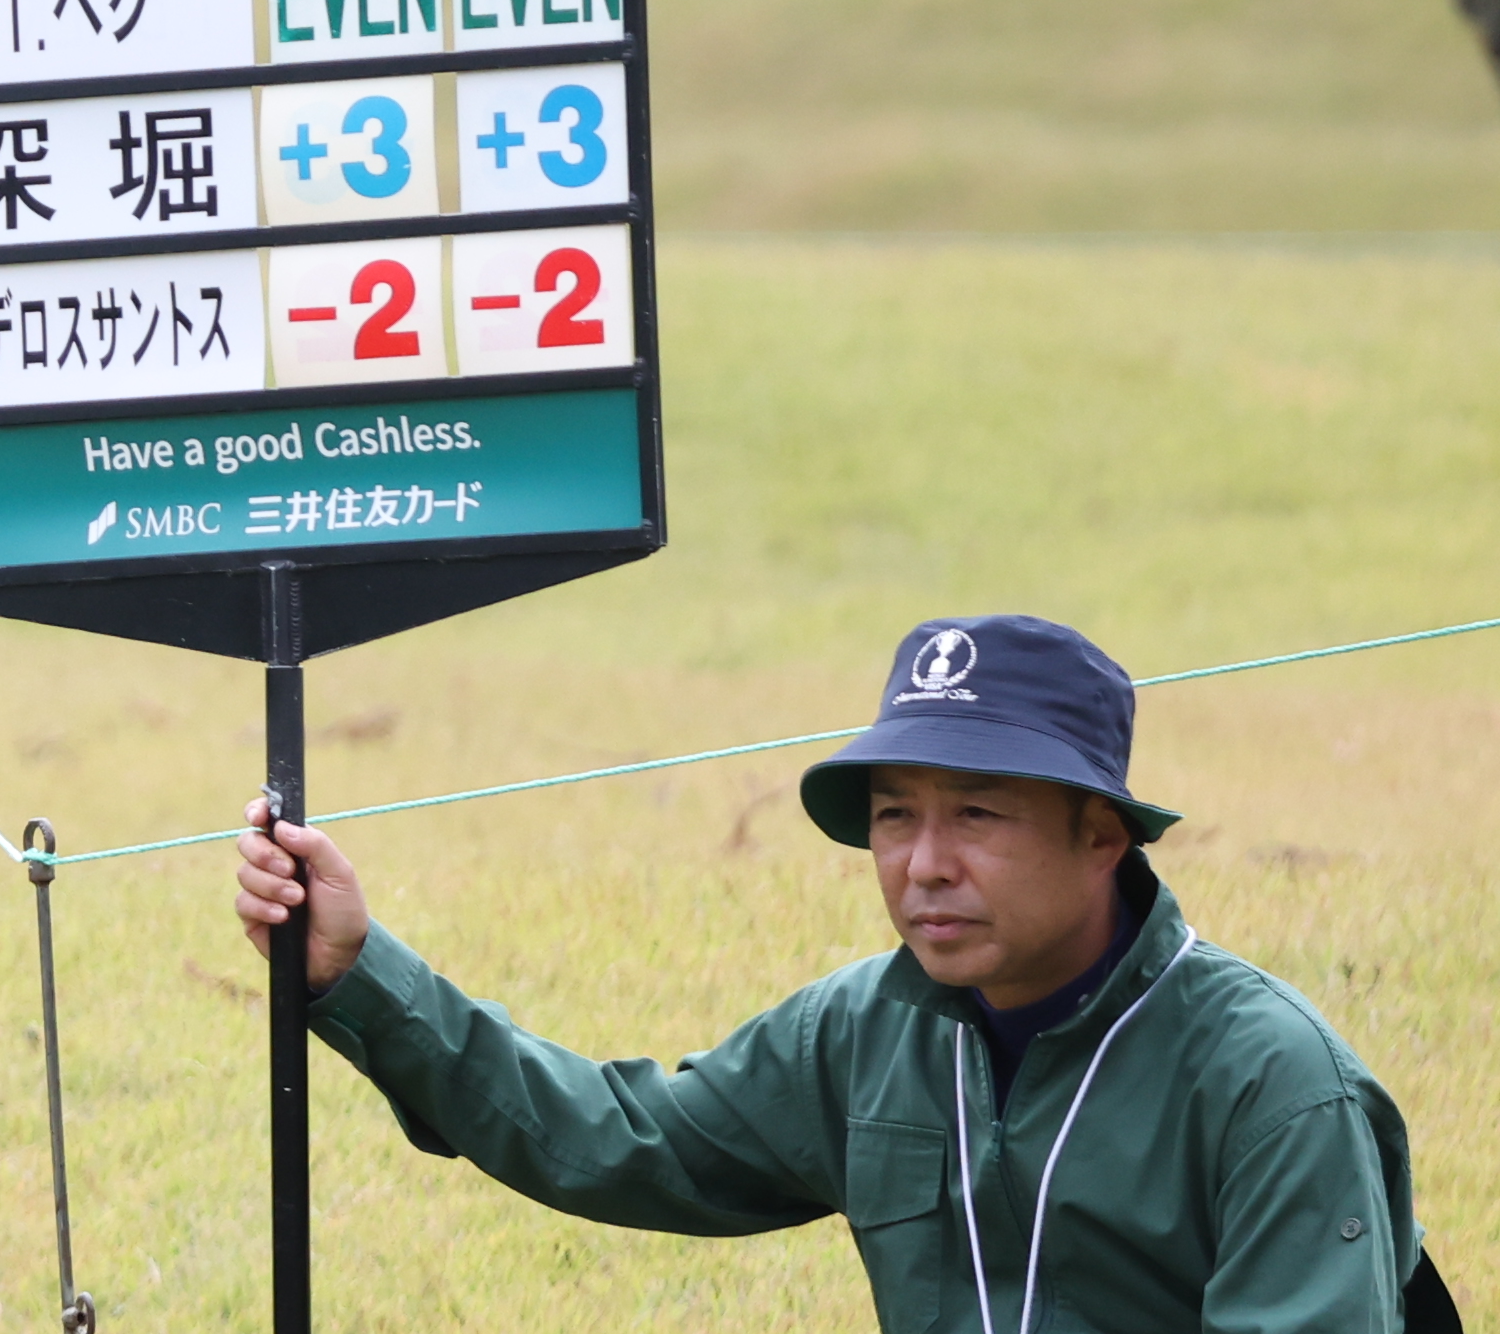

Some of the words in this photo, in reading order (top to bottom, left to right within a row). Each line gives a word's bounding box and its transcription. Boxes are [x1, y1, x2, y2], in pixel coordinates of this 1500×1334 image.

[278, 95, 412, 199] +3
[476, 84, 608, 188] +3
[287, 258, 421, 360] -2
[471, 247, 606, 348] -2
[83, 436, 174, 472] Have
[183, 437, 205, 466] a
[215, 422, 304, 474] good
[314, 415, 482, 458] Cashless.
[125, 502, 222, 539] SMBC
[245, 480, 483, 535] 三井住友カード
